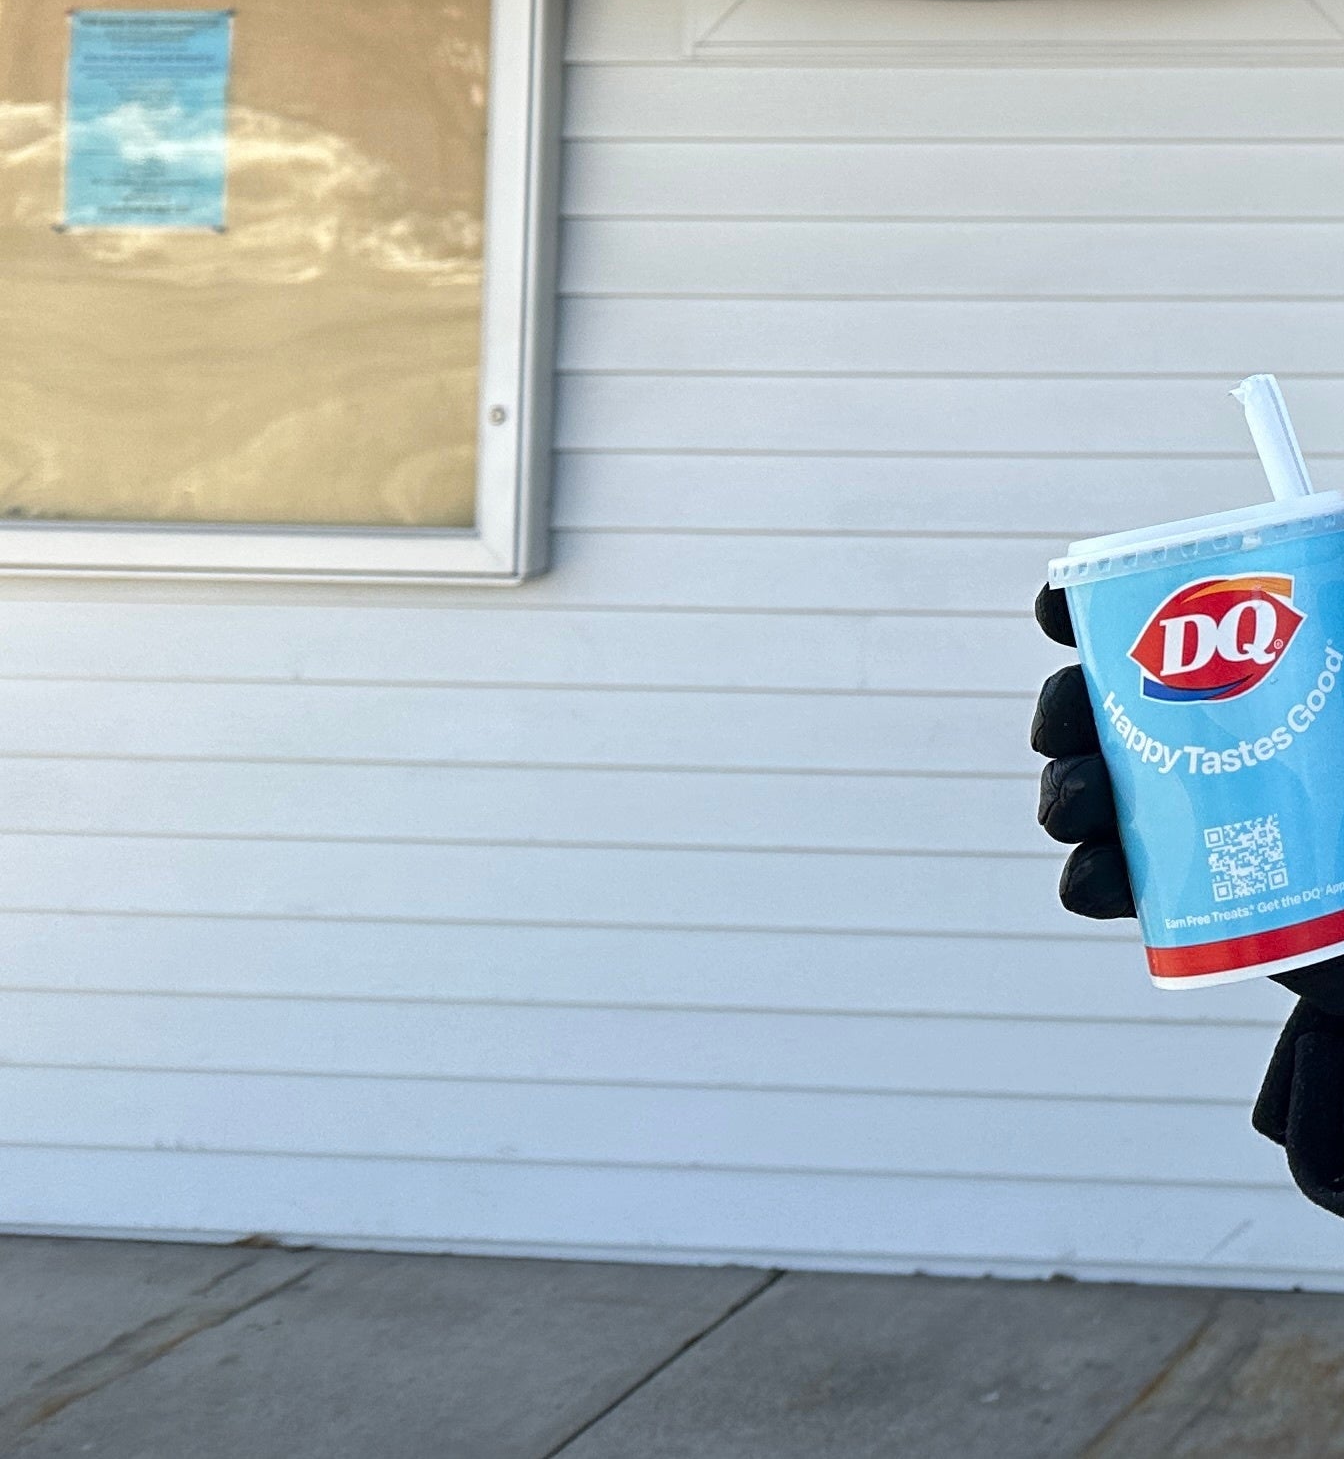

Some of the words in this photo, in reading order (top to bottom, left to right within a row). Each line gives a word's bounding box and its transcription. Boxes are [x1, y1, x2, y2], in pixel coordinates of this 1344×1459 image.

[1160, 599, 1278, 677] DQ
[1103, 690, 1183, 775] Happy
[1184, 725, 1293, 775] Tastes
[1286, 645, 1344, 733] Good
[1165, 918, 1187, 930] Earn
[1187, 914, 1212, 927] Free
[1257, 900, 1280, 913] Get
[1281, 893, 1302, 909] the
